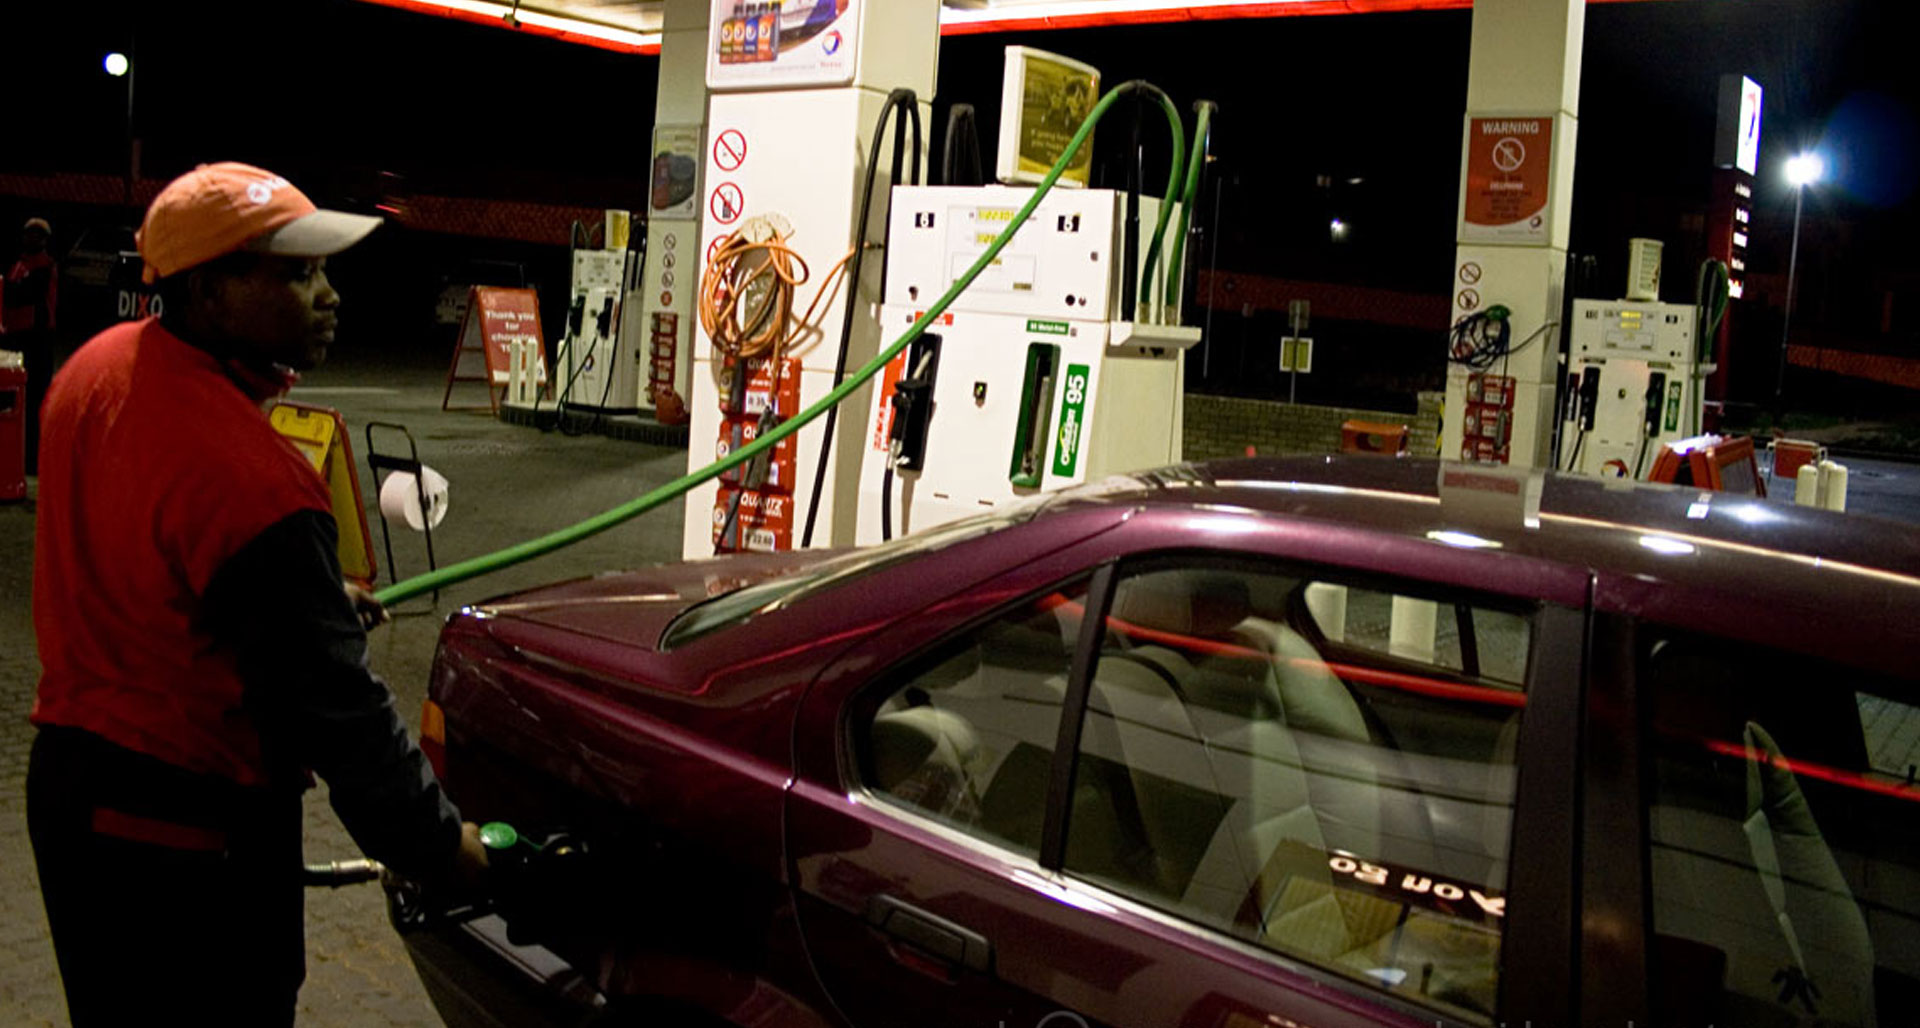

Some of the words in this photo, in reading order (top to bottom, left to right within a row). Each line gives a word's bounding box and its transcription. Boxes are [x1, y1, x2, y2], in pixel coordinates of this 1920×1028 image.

[1482, 121, 1539, 135] WARNING
[485, 310, 516, 321] Thank
[517, 312, 536, 323] you
[505, 321, 520, 331] for
[747, 357, 791, 371] QUAZ
[1066, 374, 1086, 404] 95
